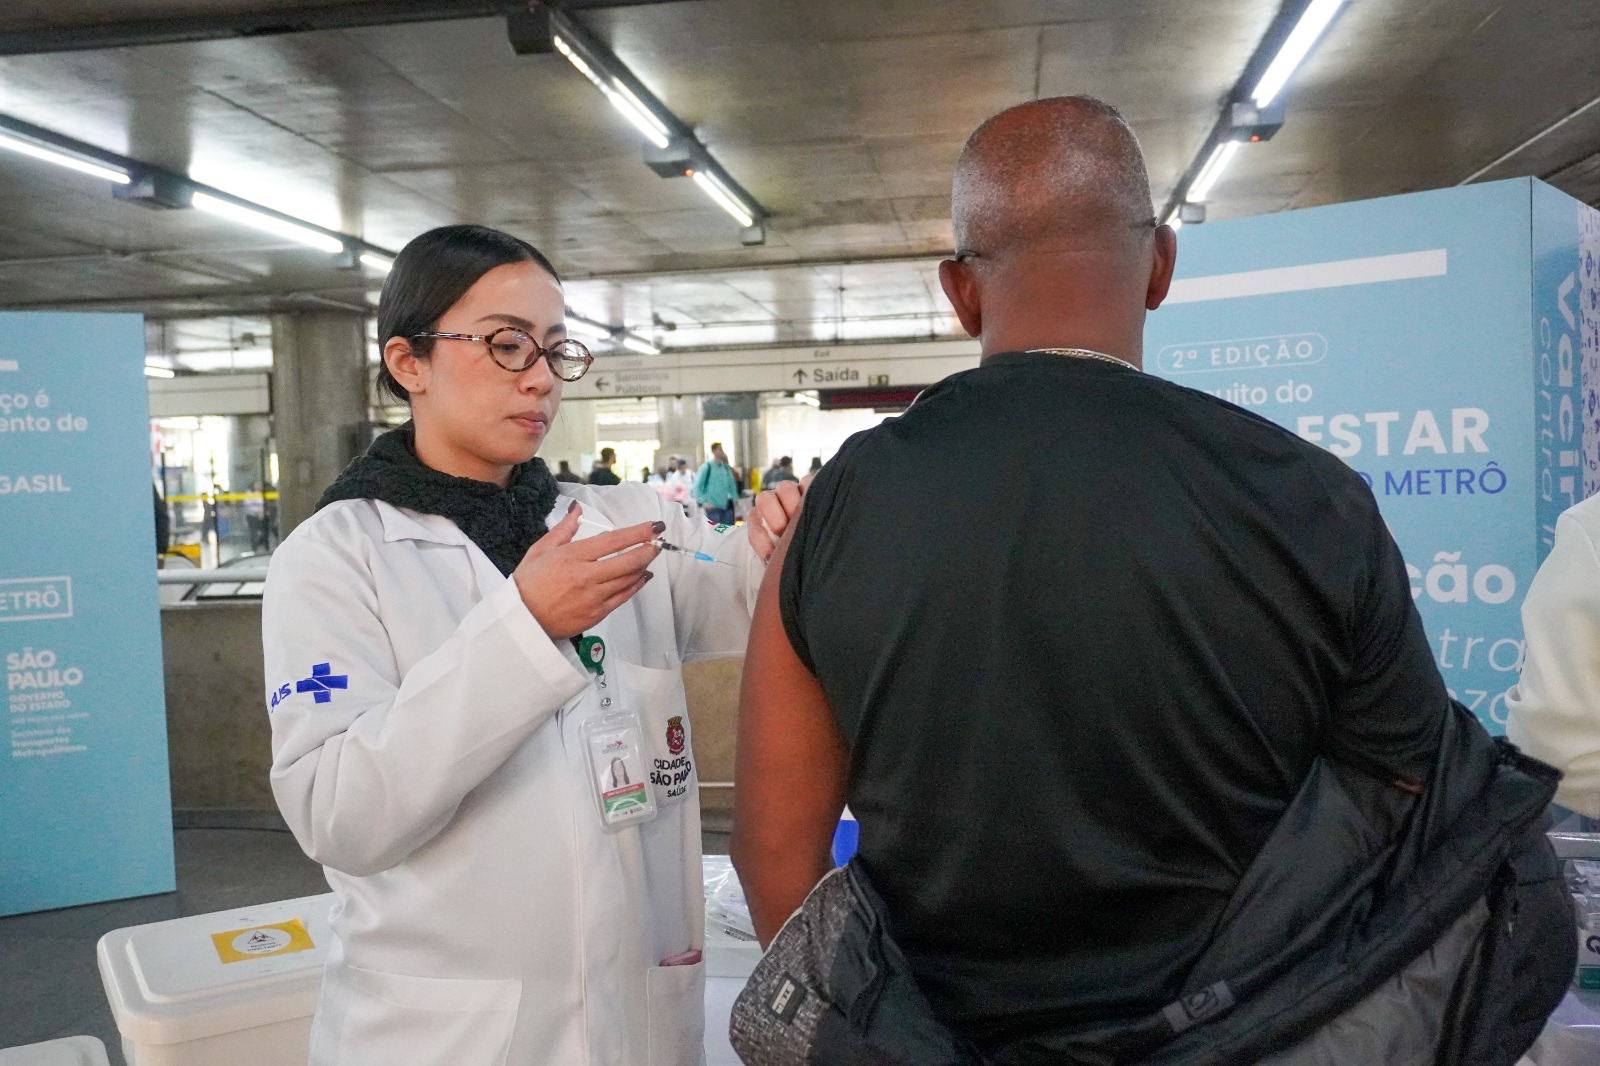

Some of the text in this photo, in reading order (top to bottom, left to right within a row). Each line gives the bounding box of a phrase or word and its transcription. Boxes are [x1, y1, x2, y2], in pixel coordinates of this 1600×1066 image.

[1211, 339, 1313, 368] EDIÇÃO
[813, 366, 860, 383] Saída
[35, 388, 49, 409] é
[1275, 379, 1313, 404] do
[56, 412, 88, 433] de
[1385, 460, 1508, 496] METRÔ
[7, 648, 57, 671] SÃO
[8, 667, 84, 691] PAULO
[653, 756, 686, 771] CIDADE
[649, 770, 672, 787] SÃO
